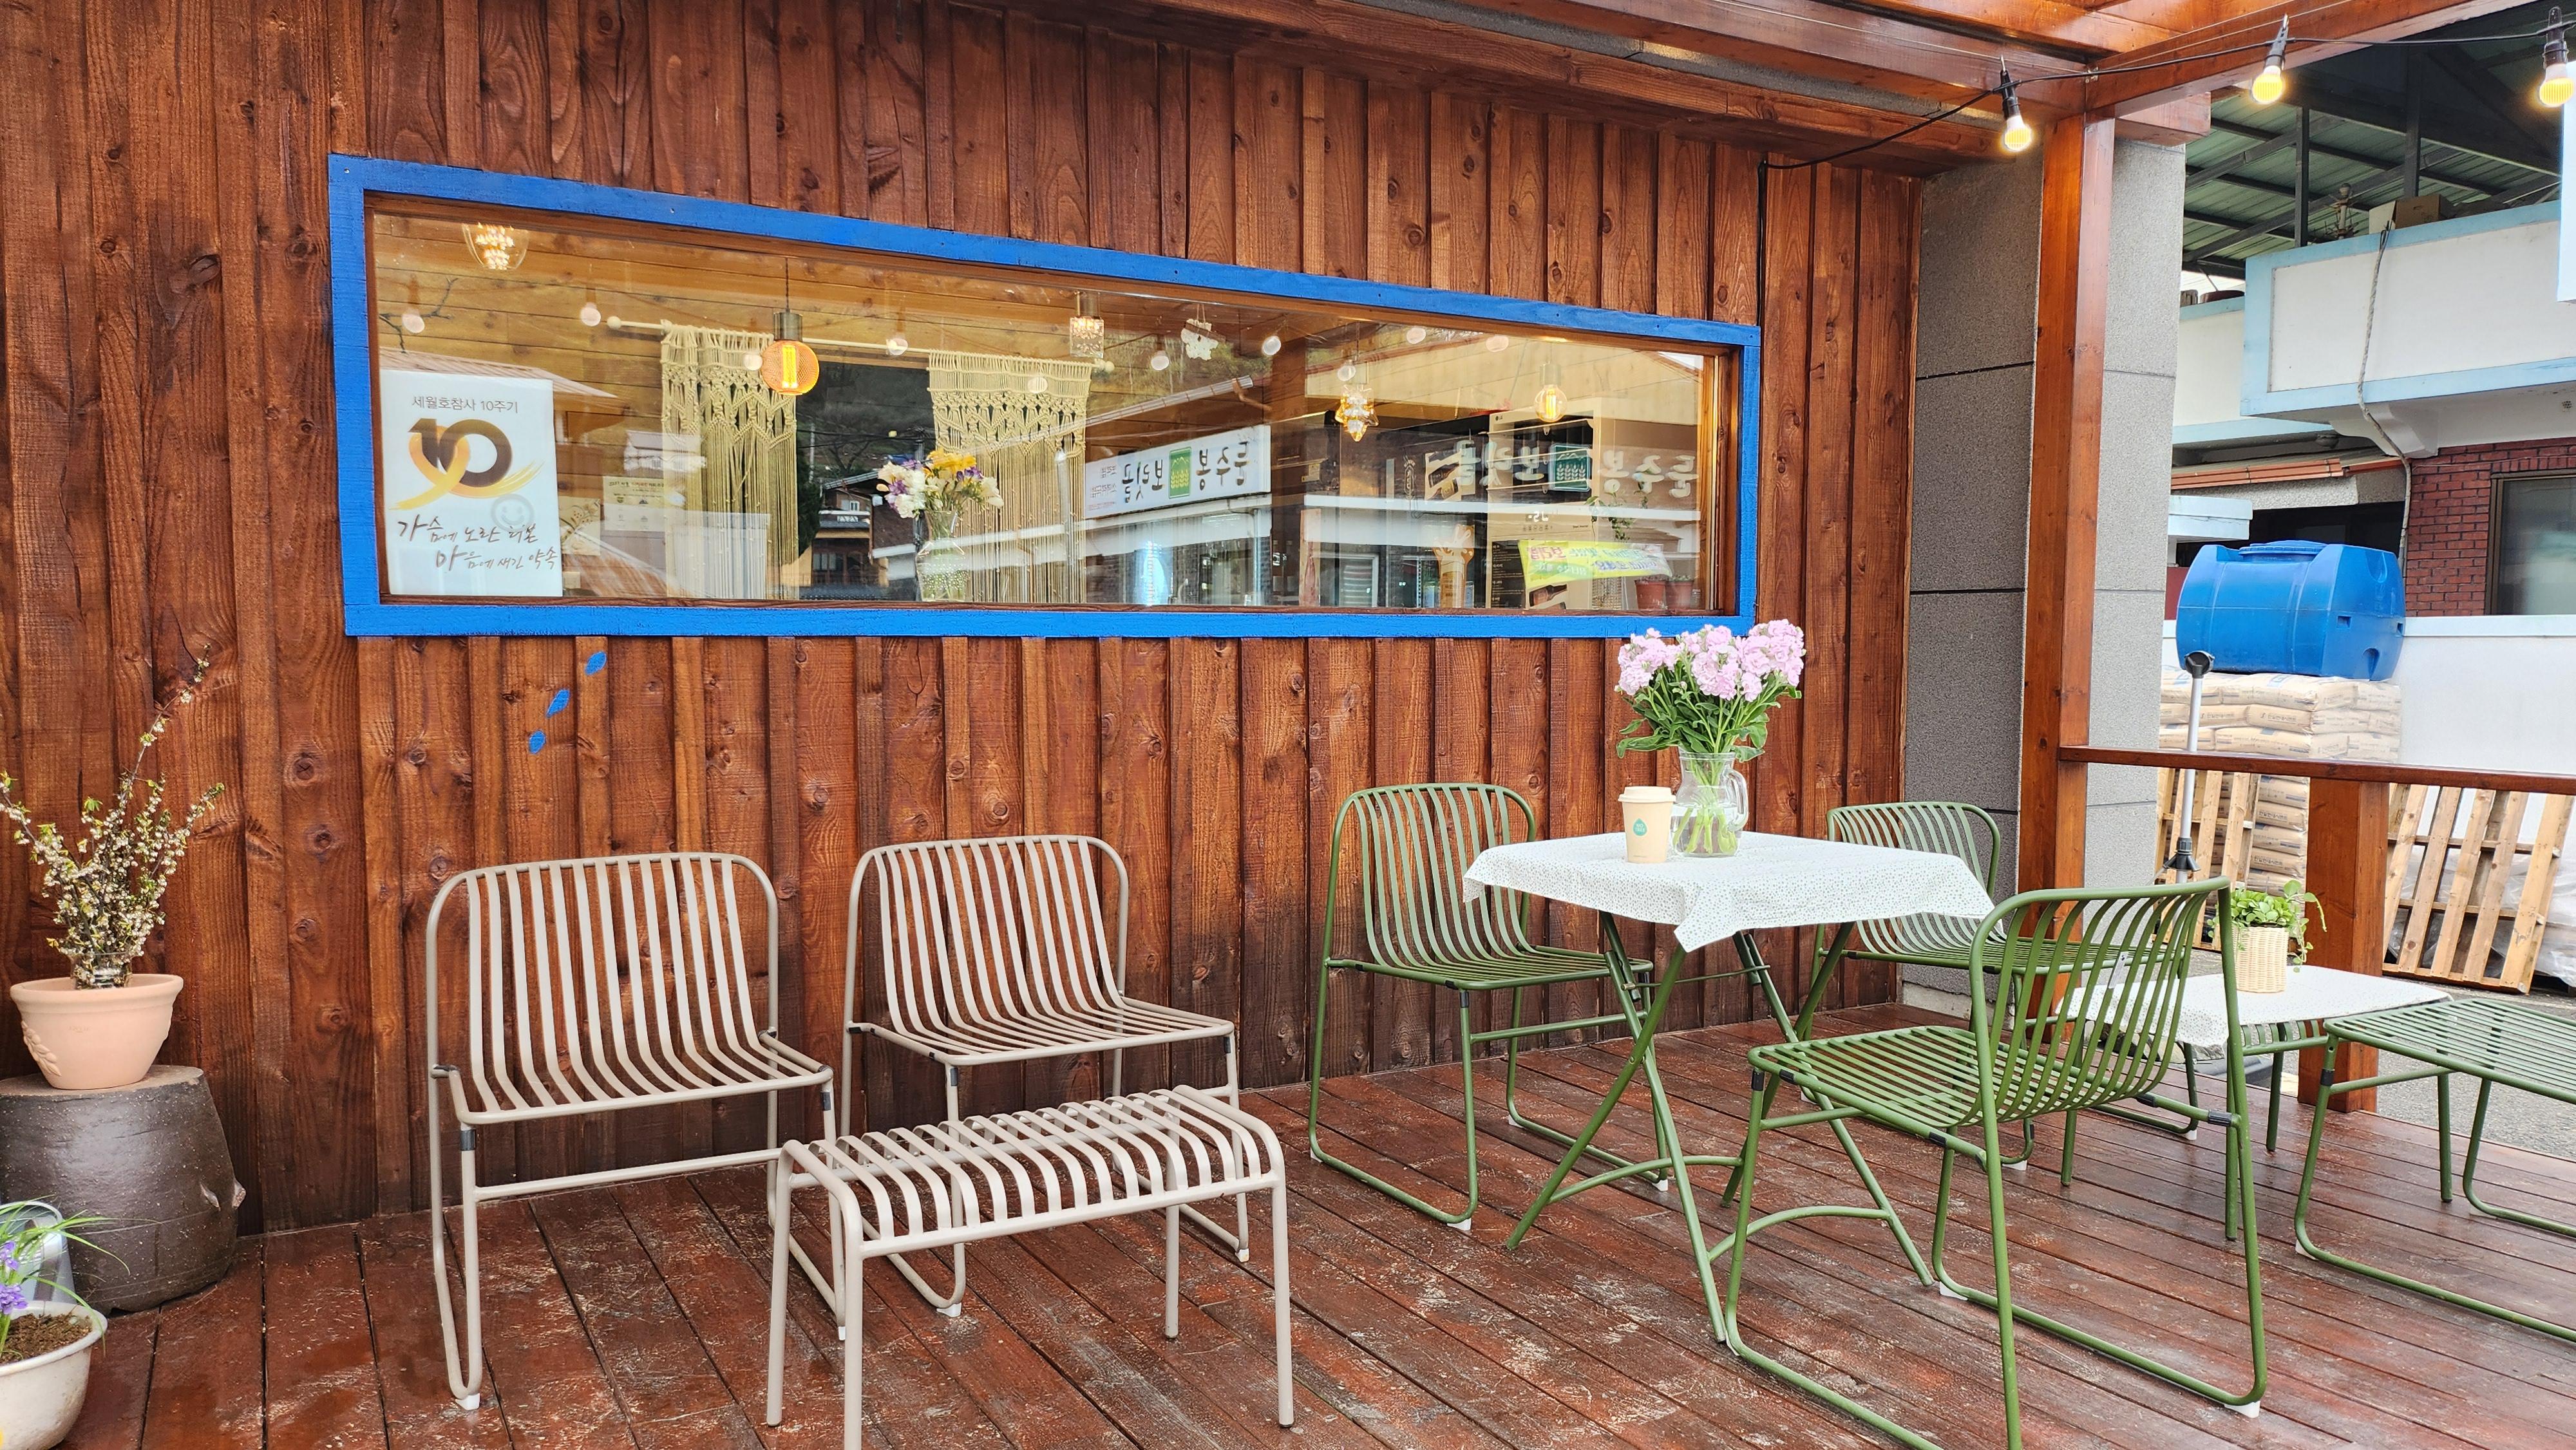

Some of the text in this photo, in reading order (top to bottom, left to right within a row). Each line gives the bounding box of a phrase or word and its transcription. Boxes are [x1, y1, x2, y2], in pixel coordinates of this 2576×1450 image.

[412, 396, 518, 413] 세월호참사 10주기
[397, 514, 458, 542] 가슴에
[465, 526, 501, 543] 노란
[436, 545, 558, 571] 마음에 새긴 약속
